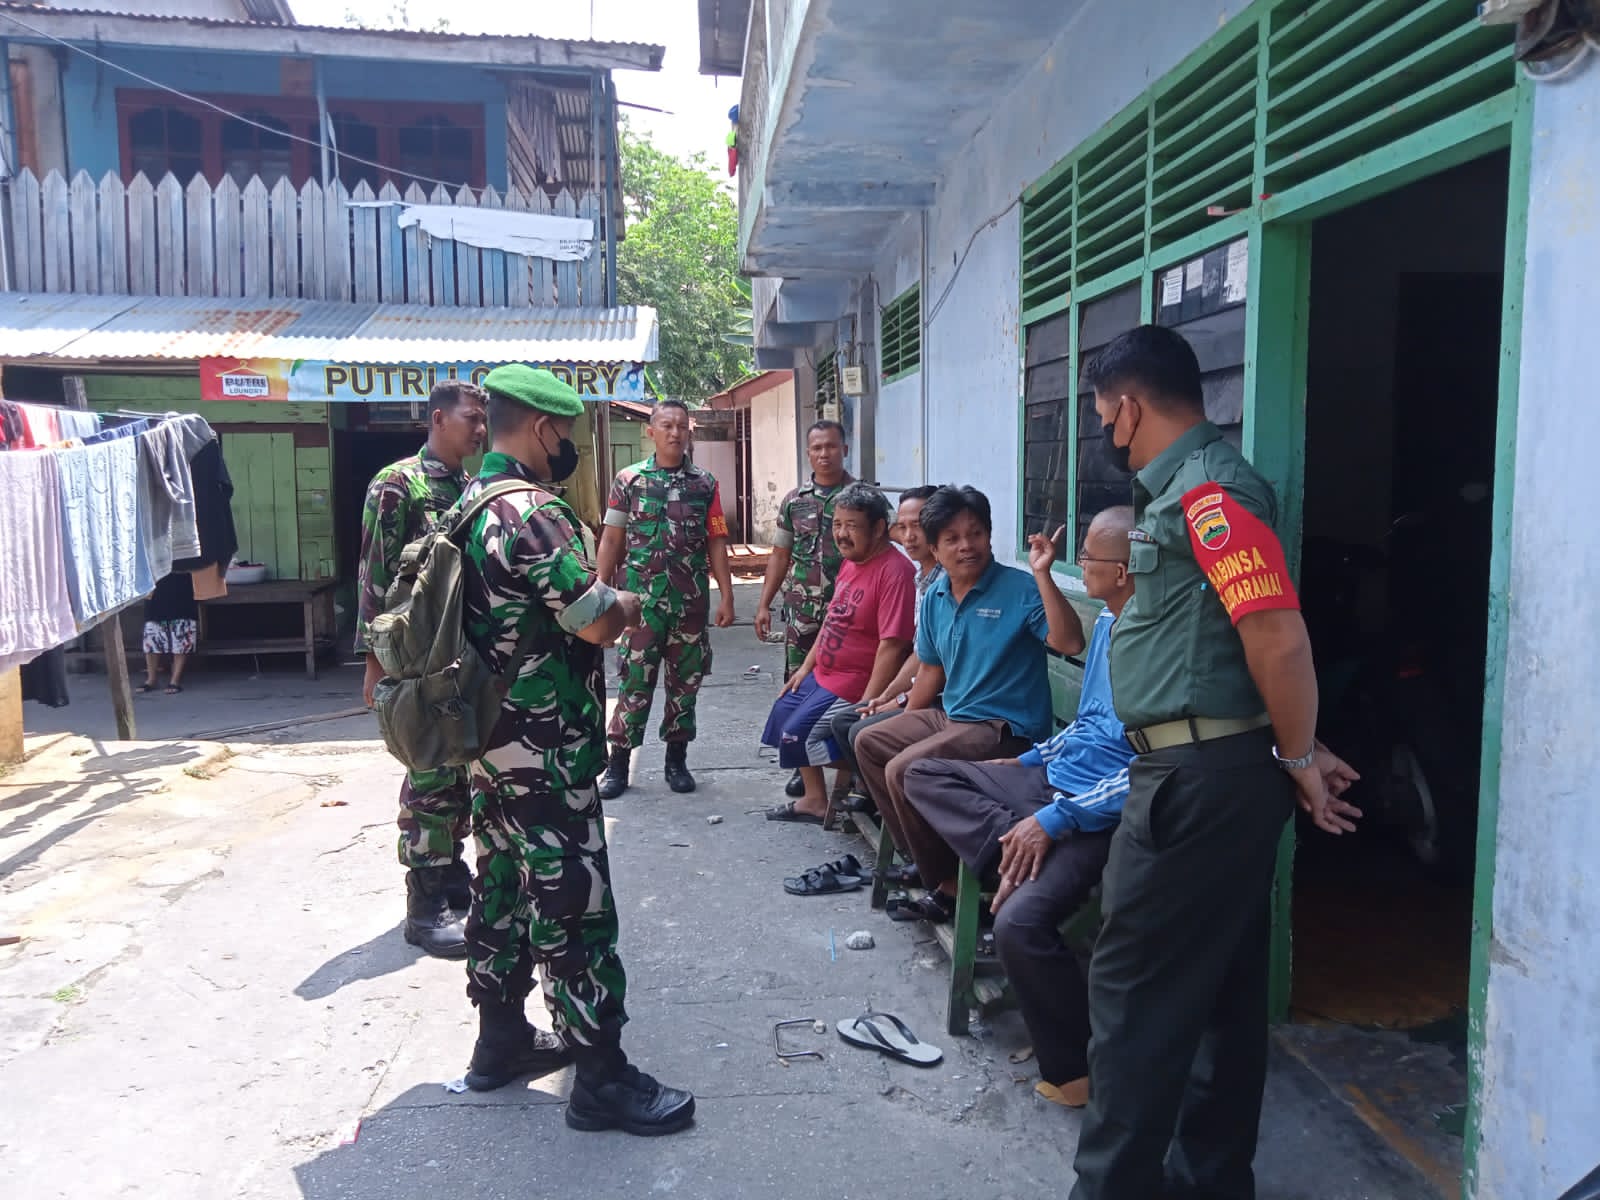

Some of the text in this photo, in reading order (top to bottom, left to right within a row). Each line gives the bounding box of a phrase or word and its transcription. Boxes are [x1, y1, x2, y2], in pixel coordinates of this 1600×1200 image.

[225, 377, 266, 387] PUTRI
[325, 366, 436, 396] PUTRI
[1221, 573, 1283, 616] KARAMAI
